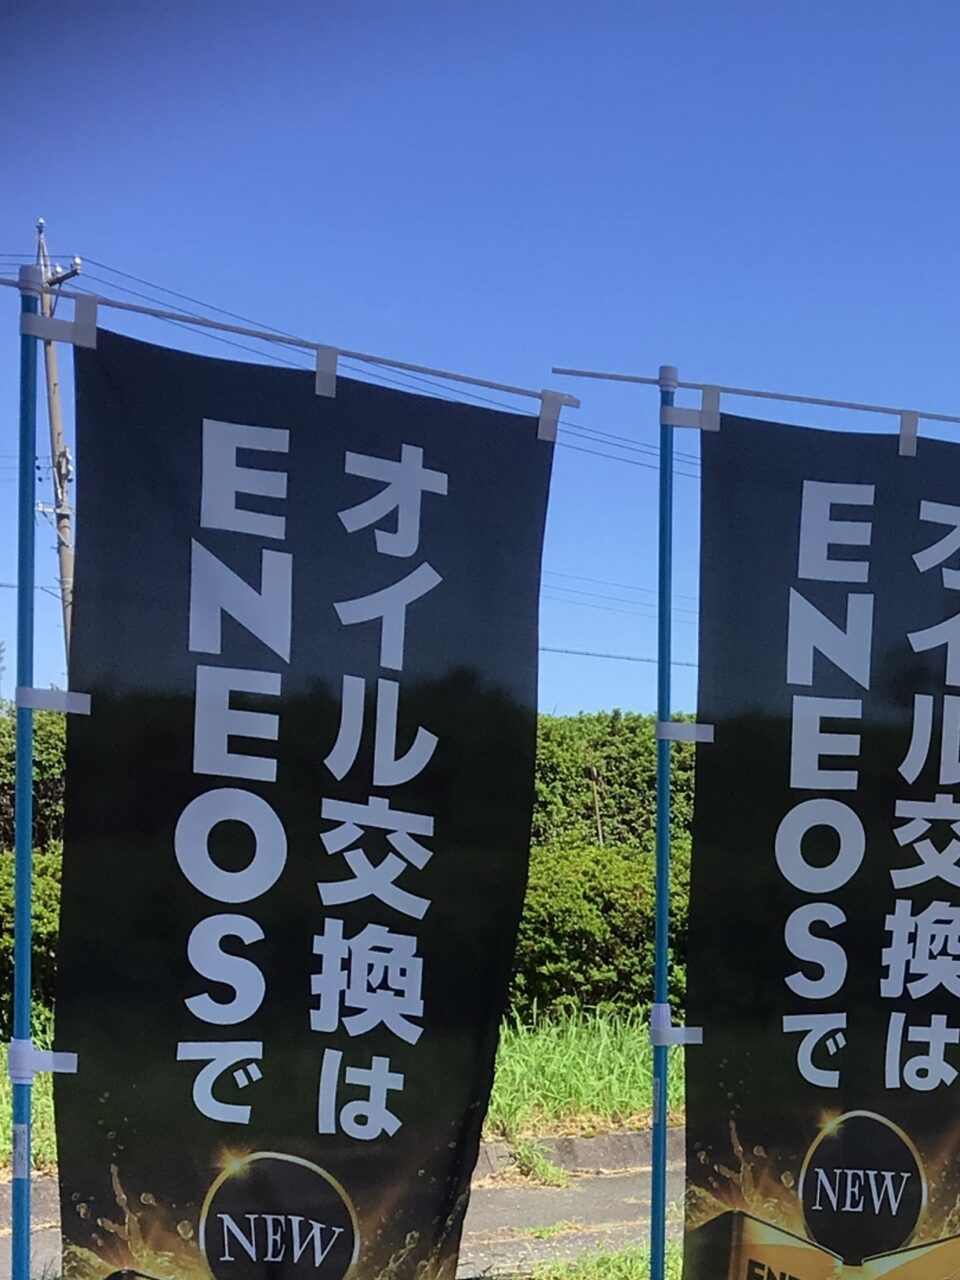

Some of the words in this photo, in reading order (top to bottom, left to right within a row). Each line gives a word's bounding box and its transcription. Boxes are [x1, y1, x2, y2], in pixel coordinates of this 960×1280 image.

[174, 418, 291, 1124] ENEOSで
[310, 444, 448, 1140] オイル交換は
[774, 479, 875, 1090] ENEOSで
[217, 1214, 344, 1267] NEW
[811, 1167, 911, 1216] NEW
